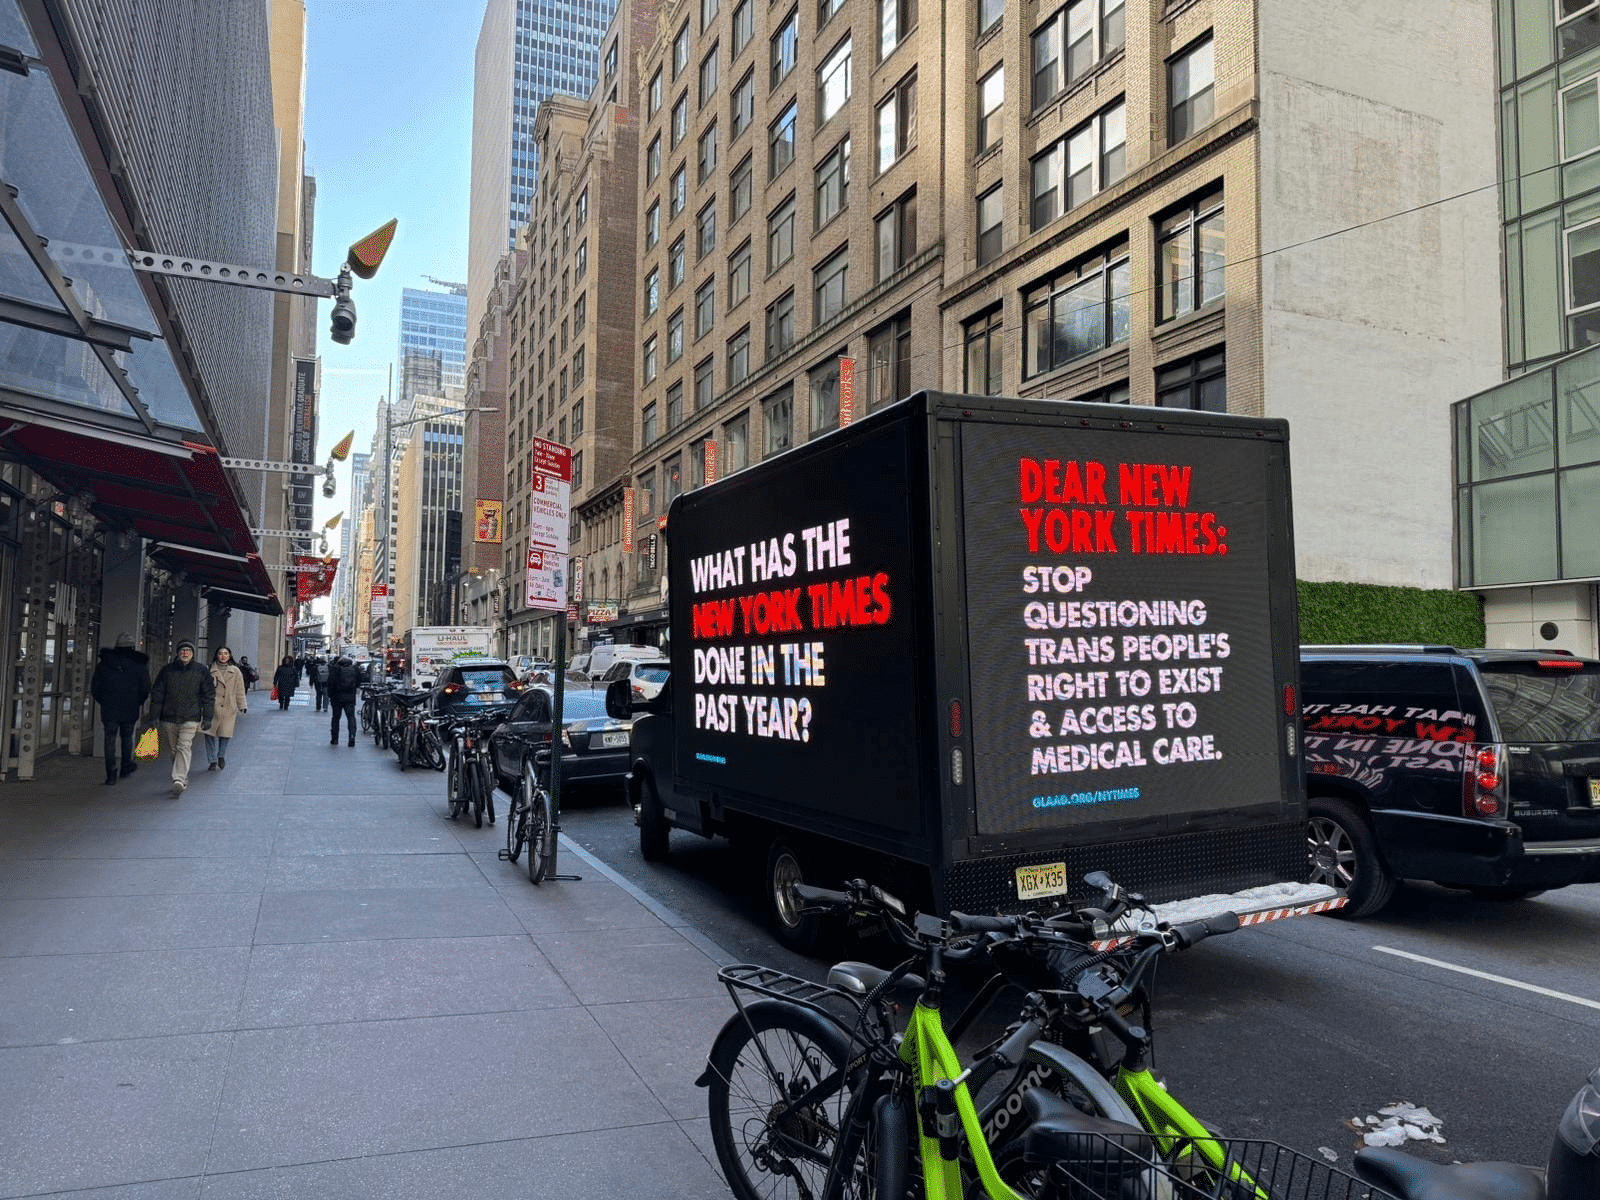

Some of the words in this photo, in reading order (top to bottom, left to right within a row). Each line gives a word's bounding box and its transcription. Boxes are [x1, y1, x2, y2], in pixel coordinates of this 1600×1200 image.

[297, 372, 305, 402] GRADUATE
[302, 439, 310, 462] SCHOOL
[534, 440, 542, 449] NO
[543, 443, 567, 457] STANDING
[535, 475, 543, 490] 3
[1020, 458, 1107, 505] DEAR
[1118, 463, 1192, 507] NEW
[533, 497, 562, 511] COMMERCIAL
[533, 506, 554, 516] VEHICLES
[556, 510, 566, 519] ONLY
[1019, 508, 1118, 554] YORK
[1125, 511, 1228, 555] TIMES:
[691, 546, 746, 593] WHAT
[751, 533, 797, 583] HAS
[802, 518, 851, 572] THE
[1022, 565, 1092, 593] STOP
[693, 598, 735, 639] NEW
[739, 588, 802, 634] YORK
[808, 572, 891, 629] TIMES
[1023, 600, 1207, 630] QUESTIONING
[694, 646, 746, 685] DONE
[751, 644, 775, 685] IN
[780, 642, 825, 687] THE
[1024, 635, 1115, 665] TRANS
[1122, 633, 1231, 661] PEOPLE'S
[1027, 671, 1109, 701] RIGHT
[1115, 669, 1152, 697] TO
[1158, 666, 1223, 695] EXIST
[695, 693, 737, 733] PAST
[742, 695, 812, 743] YEAR?
[1029, 710, 1052, 738] &
[1059, 703, 1156, 736] ACCESS
[1162, 701, 1197, 729] TO
[1030, 740, 1147, 775] MEDICAL
[1152, 735, 1223, 765] CARE.
[1032, 787, 1140, 808] GLAAD.ORG/NYTIMES
